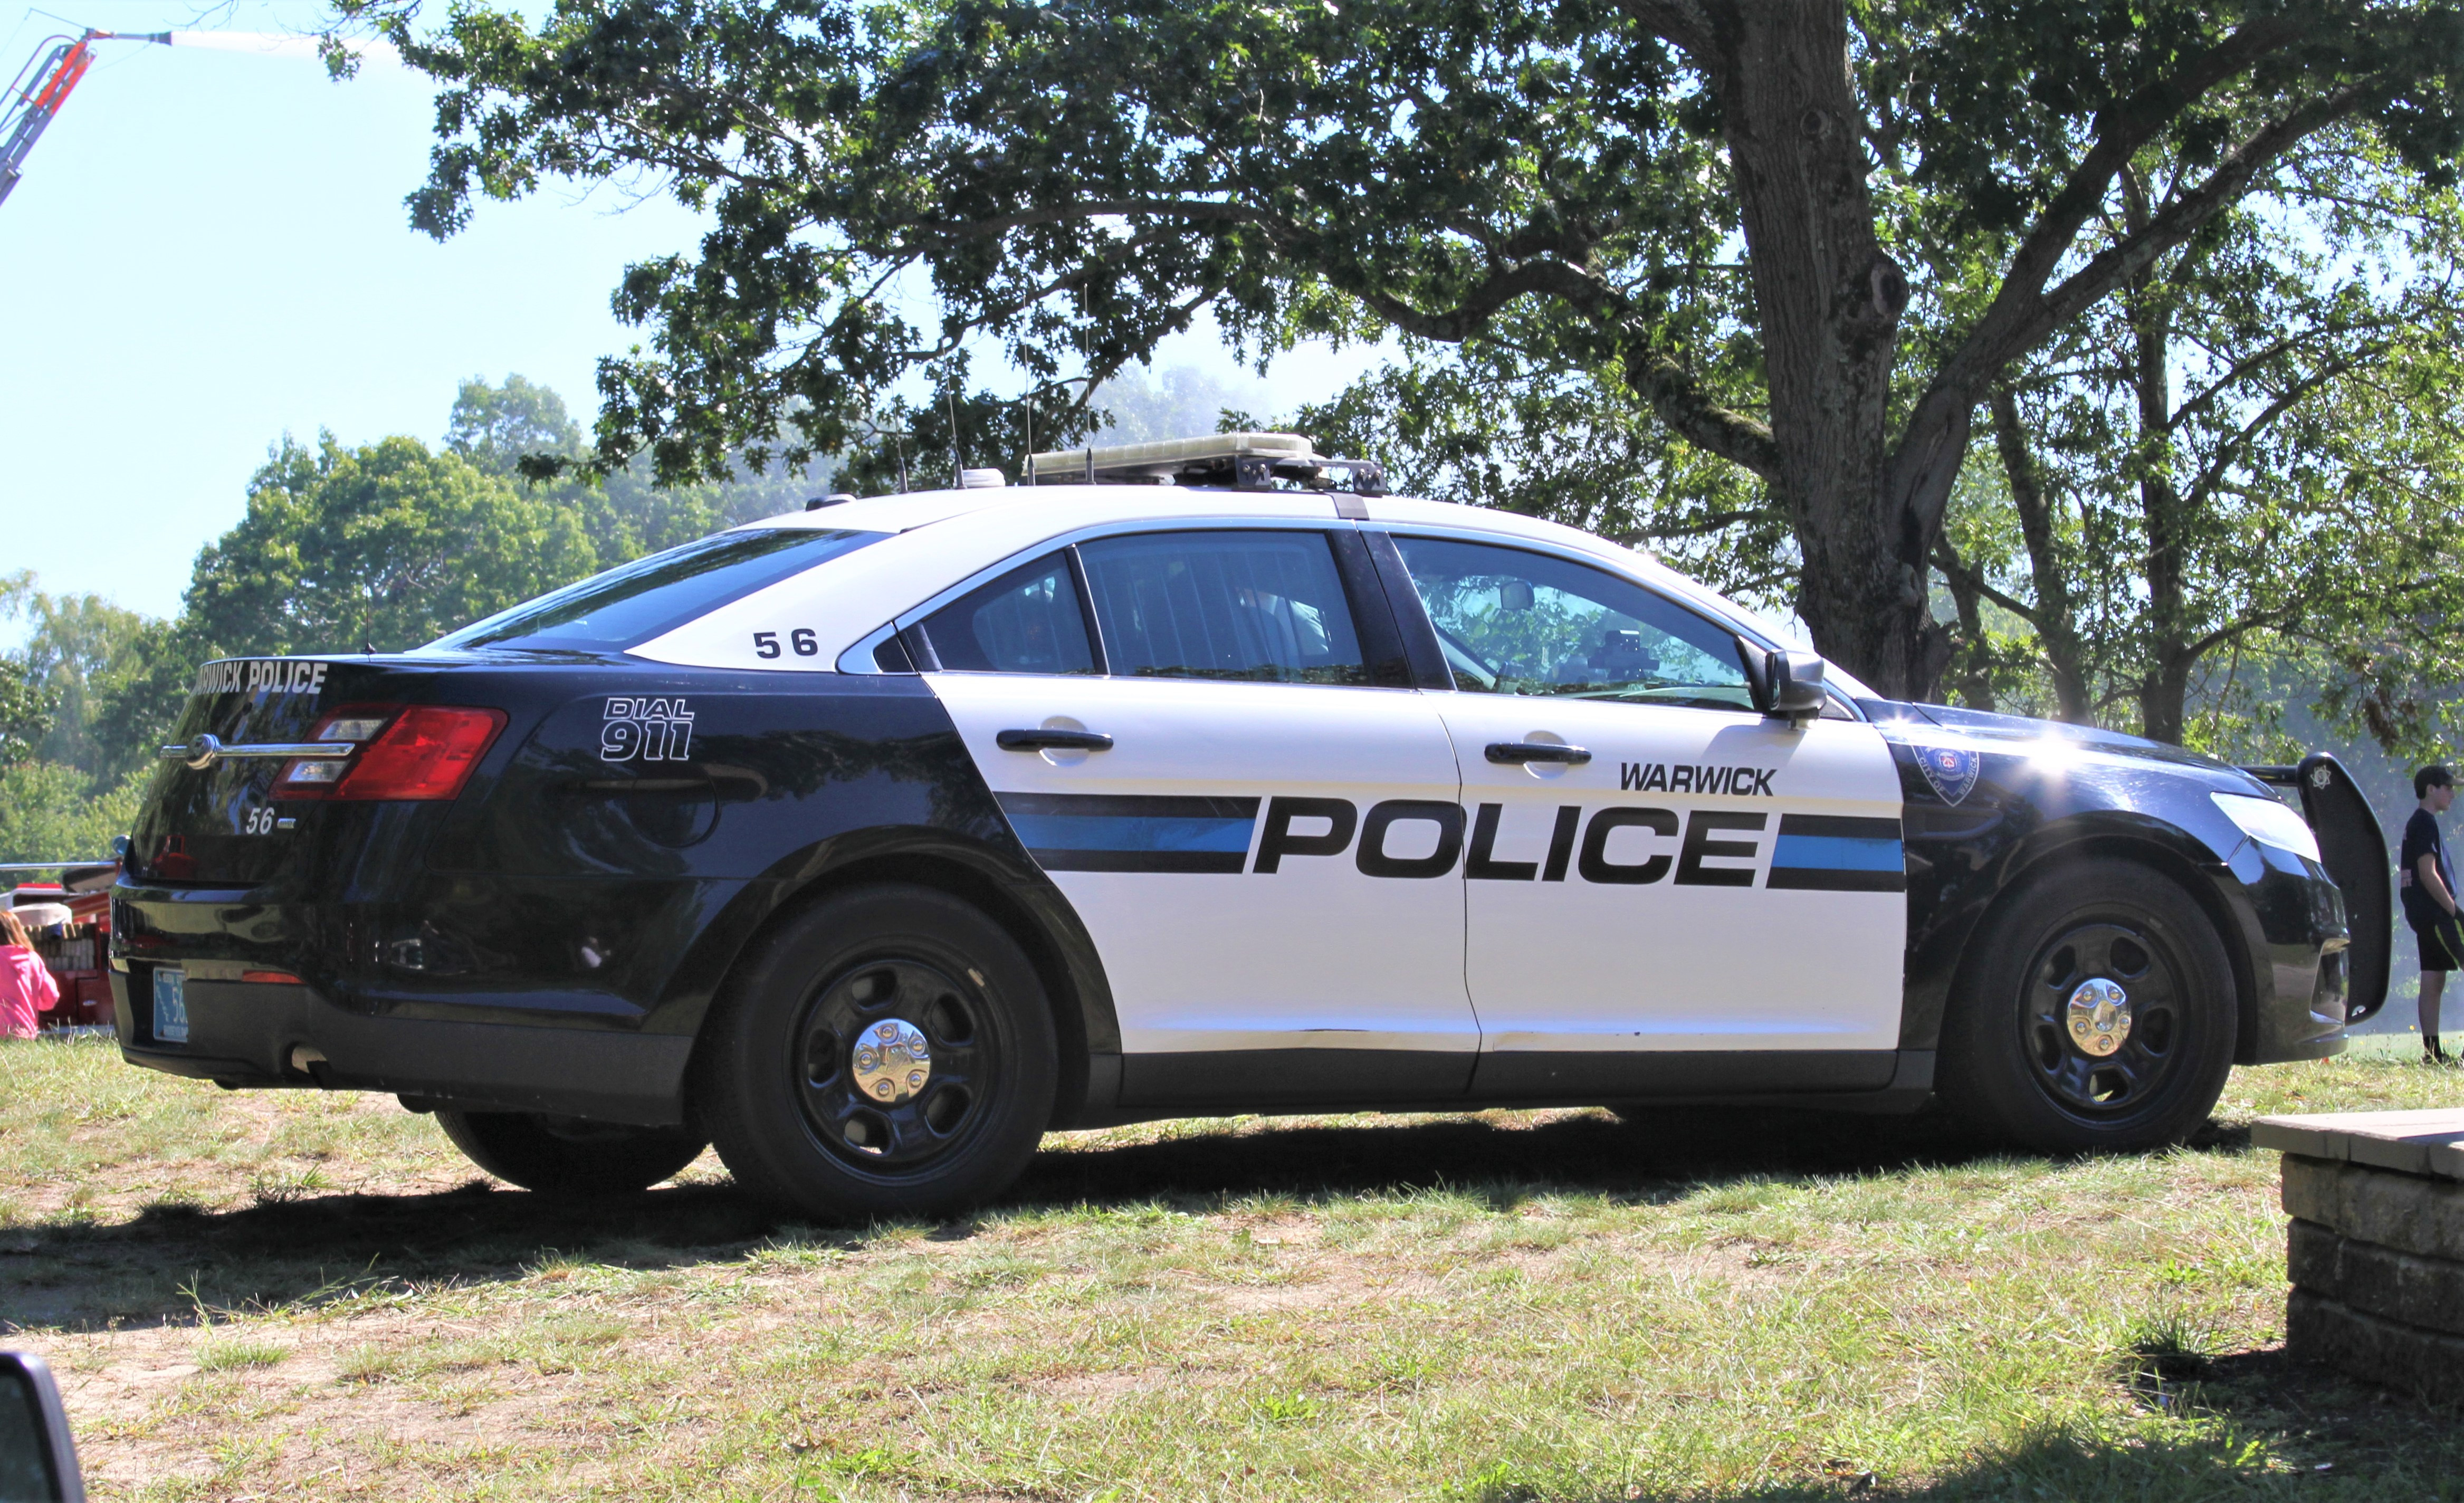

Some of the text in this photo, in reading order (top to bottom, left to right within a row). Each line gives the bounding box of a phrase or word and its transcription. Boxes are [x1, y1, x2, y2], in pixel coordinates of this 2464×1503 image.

[246, 660, 328, 695] POLICE
[603, 697, 695, 721] DIAL
[600, 719, 693, 762] 911
[1621, 762, 1778, 797] WARWICK
[1919, 757, 1934, 778] CITY
[1933, 780, 1946, 792] OF
[1958, 757, 1977, 795] WARWICK
[246, 807, 275, 835] 56
[1252, 796, 1769, 887] POLICE
